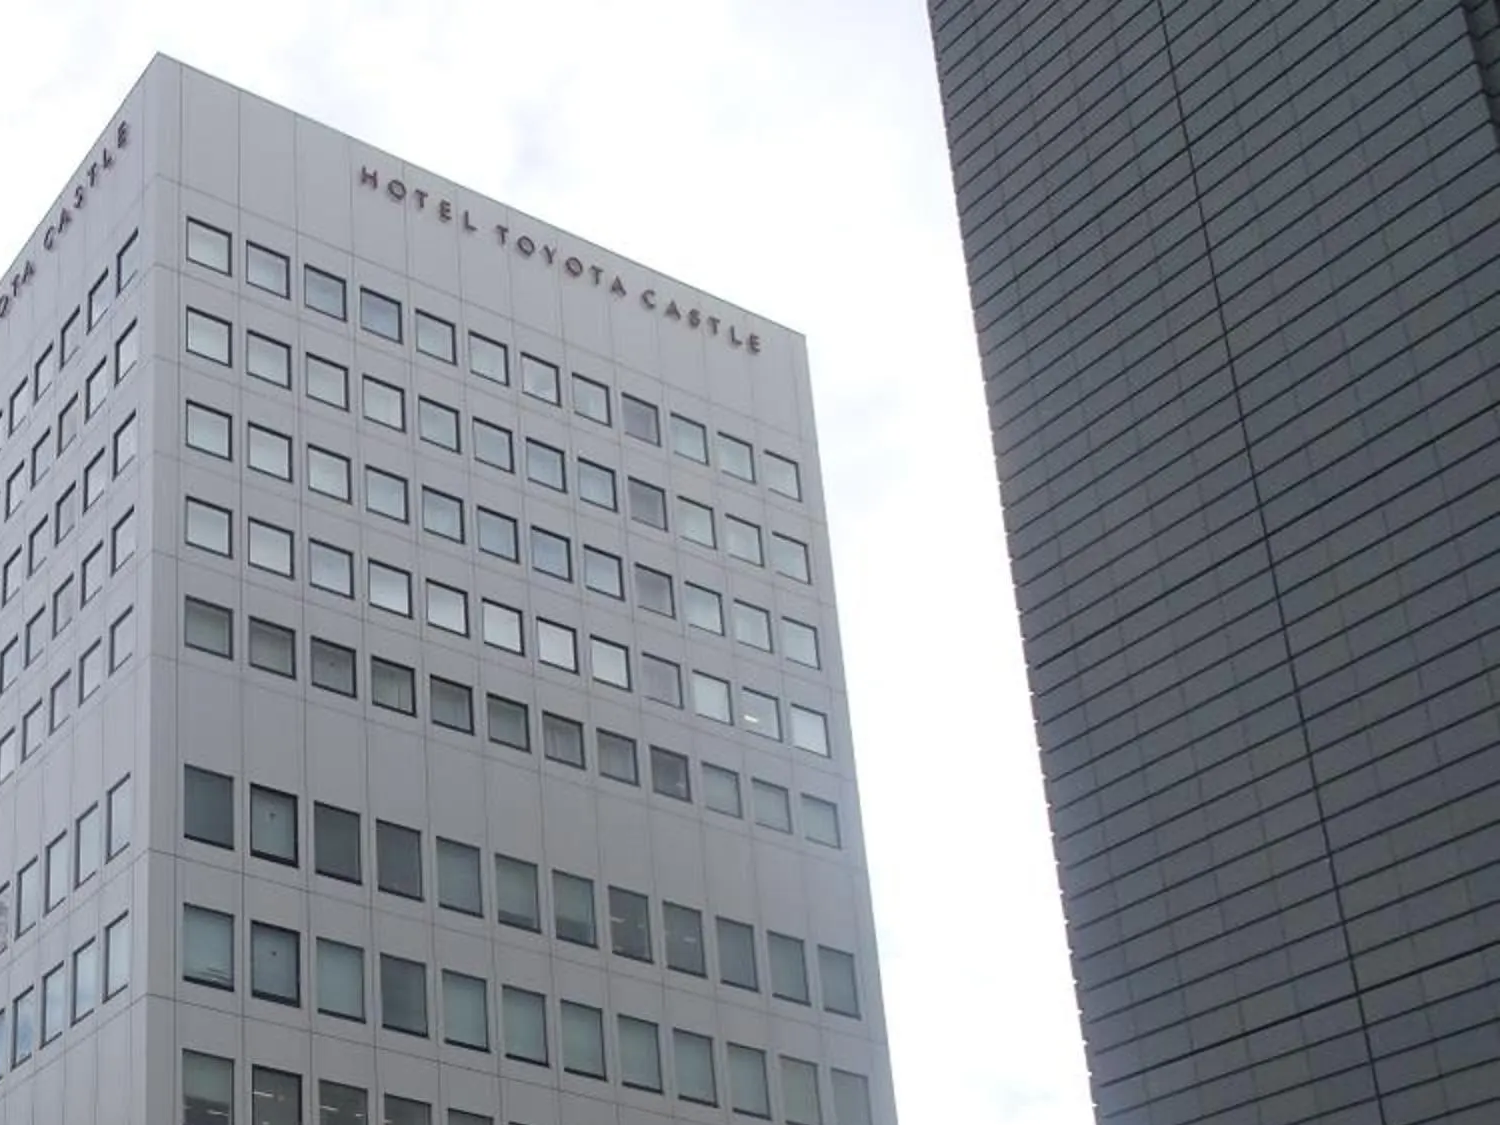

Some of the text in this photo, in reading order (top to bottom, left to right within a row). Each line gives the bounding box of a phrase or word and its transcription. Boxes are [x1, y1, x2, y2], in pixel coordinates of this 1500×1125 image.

[43, 120, 129, 251] CASTLE
[360, 165, 761, 354] HOTEL TOYOTA CASTLE
